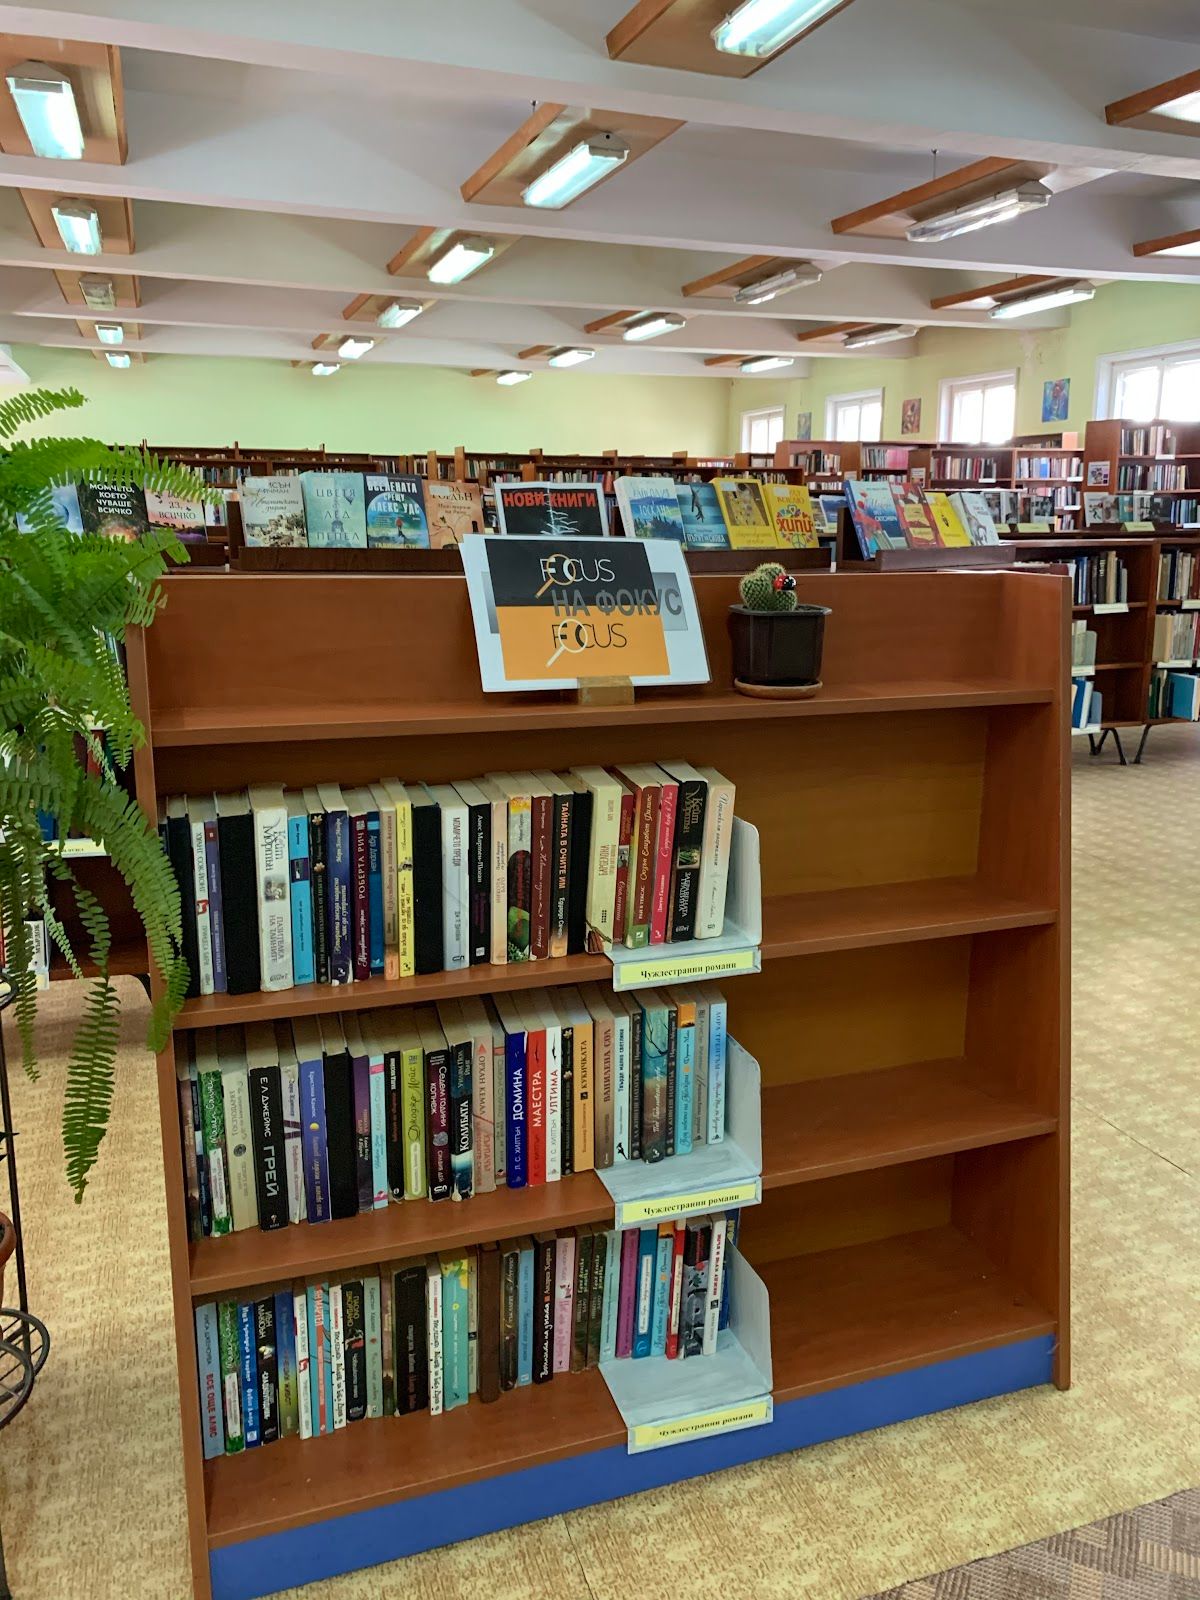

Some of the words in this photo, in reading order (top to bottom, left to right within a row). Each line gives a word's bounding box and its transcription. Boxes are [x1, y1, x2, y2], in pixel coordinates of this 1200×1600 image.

[96, 499, 131, 507] ЧУВАШЕ
[98, 506, 132, 515] ВСИЧКО
[371, 502, 398, 512] АЛЕКС
[504, 493, 545, 507] НОВИ
[550, 493, 595, 508] КНИГИ
[159, 511, 195, 520] ВСИЧКО
[540, 557, 615, 582] FOCUS
[552, 590, 590, 616] НА
[595, 588, 682, 616] ФОКУС
[552, 622, 627, 648] FOCUS
[560, 802, 569, 837] ТАЙНАТА
[692, 798, 703, 823] Кейт
[273, 830, 286, 860] Кейт
[357, 832, 365, 851] РИЧ
[452, 818, 460, 847] МОМИЧЕТО
[261, 825, 274, 871] Мортън
[559, 848, 567, 873] ОЧИТЕ
[358, 856, 366, 899] РОБЕРТА
[559, 877, 566, 888] ИМ
[269, 915, 277, 925] НА
[276, 917, 284, 959] ПАЗИТЕЛКА
[641, 962, 702, 979] Чуждестранни
[705, 961, 736, 974] романи
[438, 1067, 447, 1096] Седем
[478, 1056, 486, 1084] ОРХАН
[430, 1083, 438, 1115] копнеж
[512, 1068, 523, 1120] ДОМИНА
[532, 1071, 542, 1127] МАЕСТРА
[550, 1070, 558, 1115] УЛТИМА
[261, 1095, 271, 1137] ДЖЕЙМС
[439, 1098, 447, 1127] години
[459, 1100, 469, 1151] КОЛИБАТА
[263, 1146, 279, 1196] ГРЕЙ
[644, 1198, 706, 1216] Чуждестранни
[708, 1193, 740, 1207] романи
[206, 1374, 214, 1391] ВСЕ
[206, 1393, 215, 1413] ОЩЕ
[209, 1416, 217, 1438] АЛИС
[660, 1420, 720, 1436] Чуждестранни
[723, 1412, 754, 1426] романи
